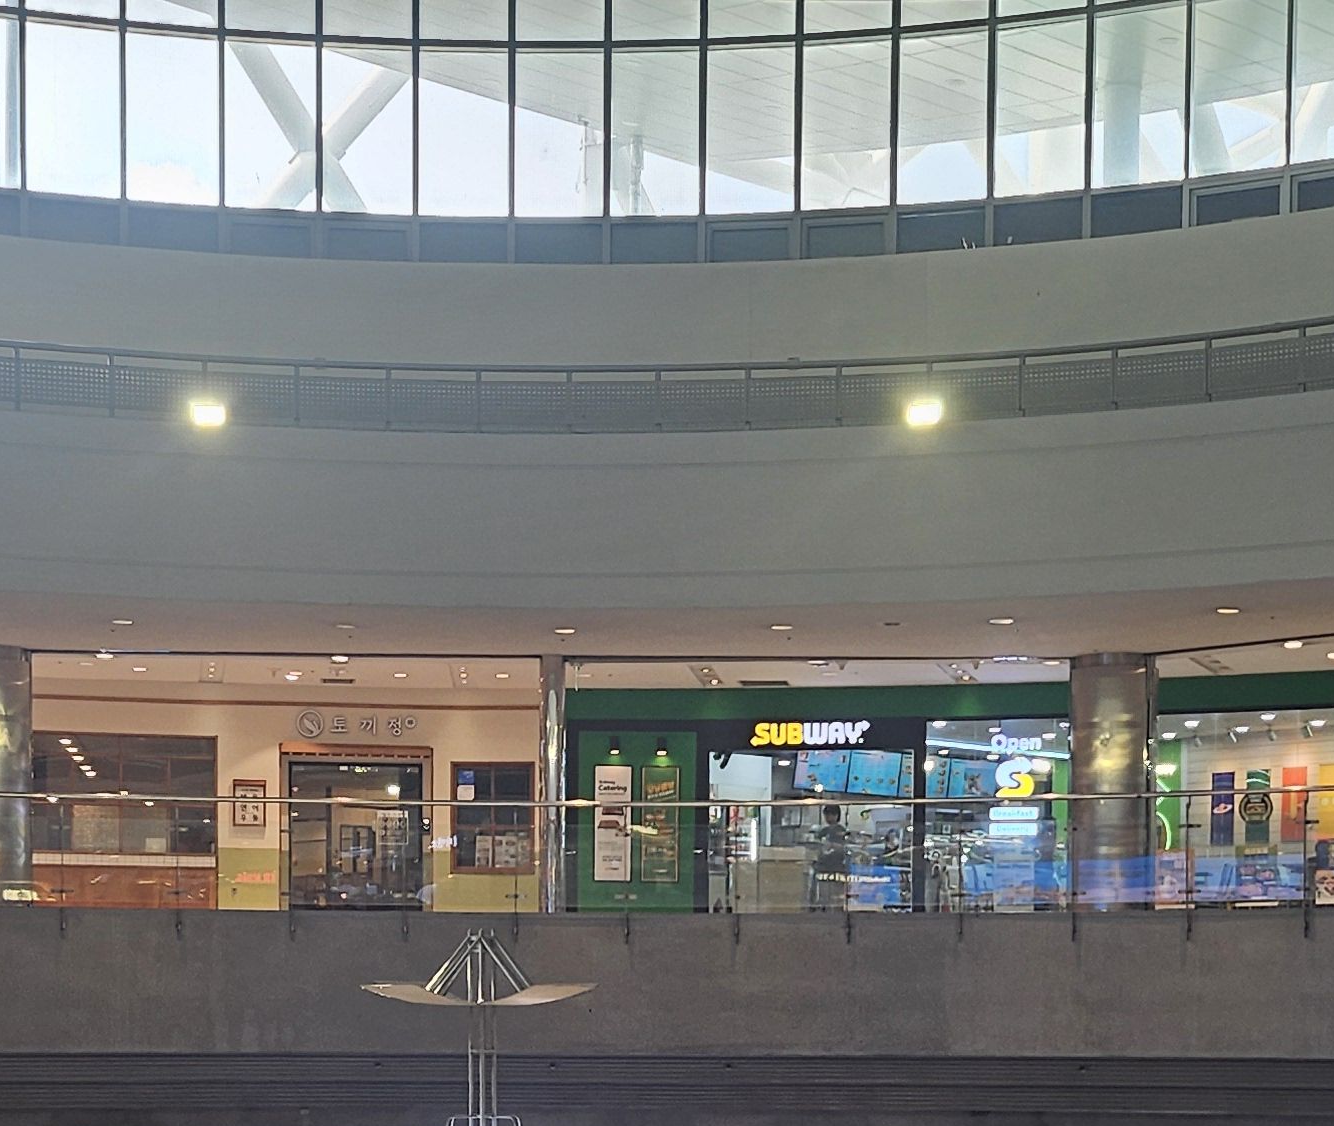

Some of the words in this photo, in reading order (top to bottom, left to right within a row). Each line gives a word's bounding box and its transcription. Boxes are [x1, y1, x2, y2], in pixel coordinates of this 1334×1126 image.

[330, 717, 403, 736] 토끼정
[750, 720, 871, 747] SUBWAY
[991, 734, 1042, 755] Open
[598, 785, 627, 793] Catering
